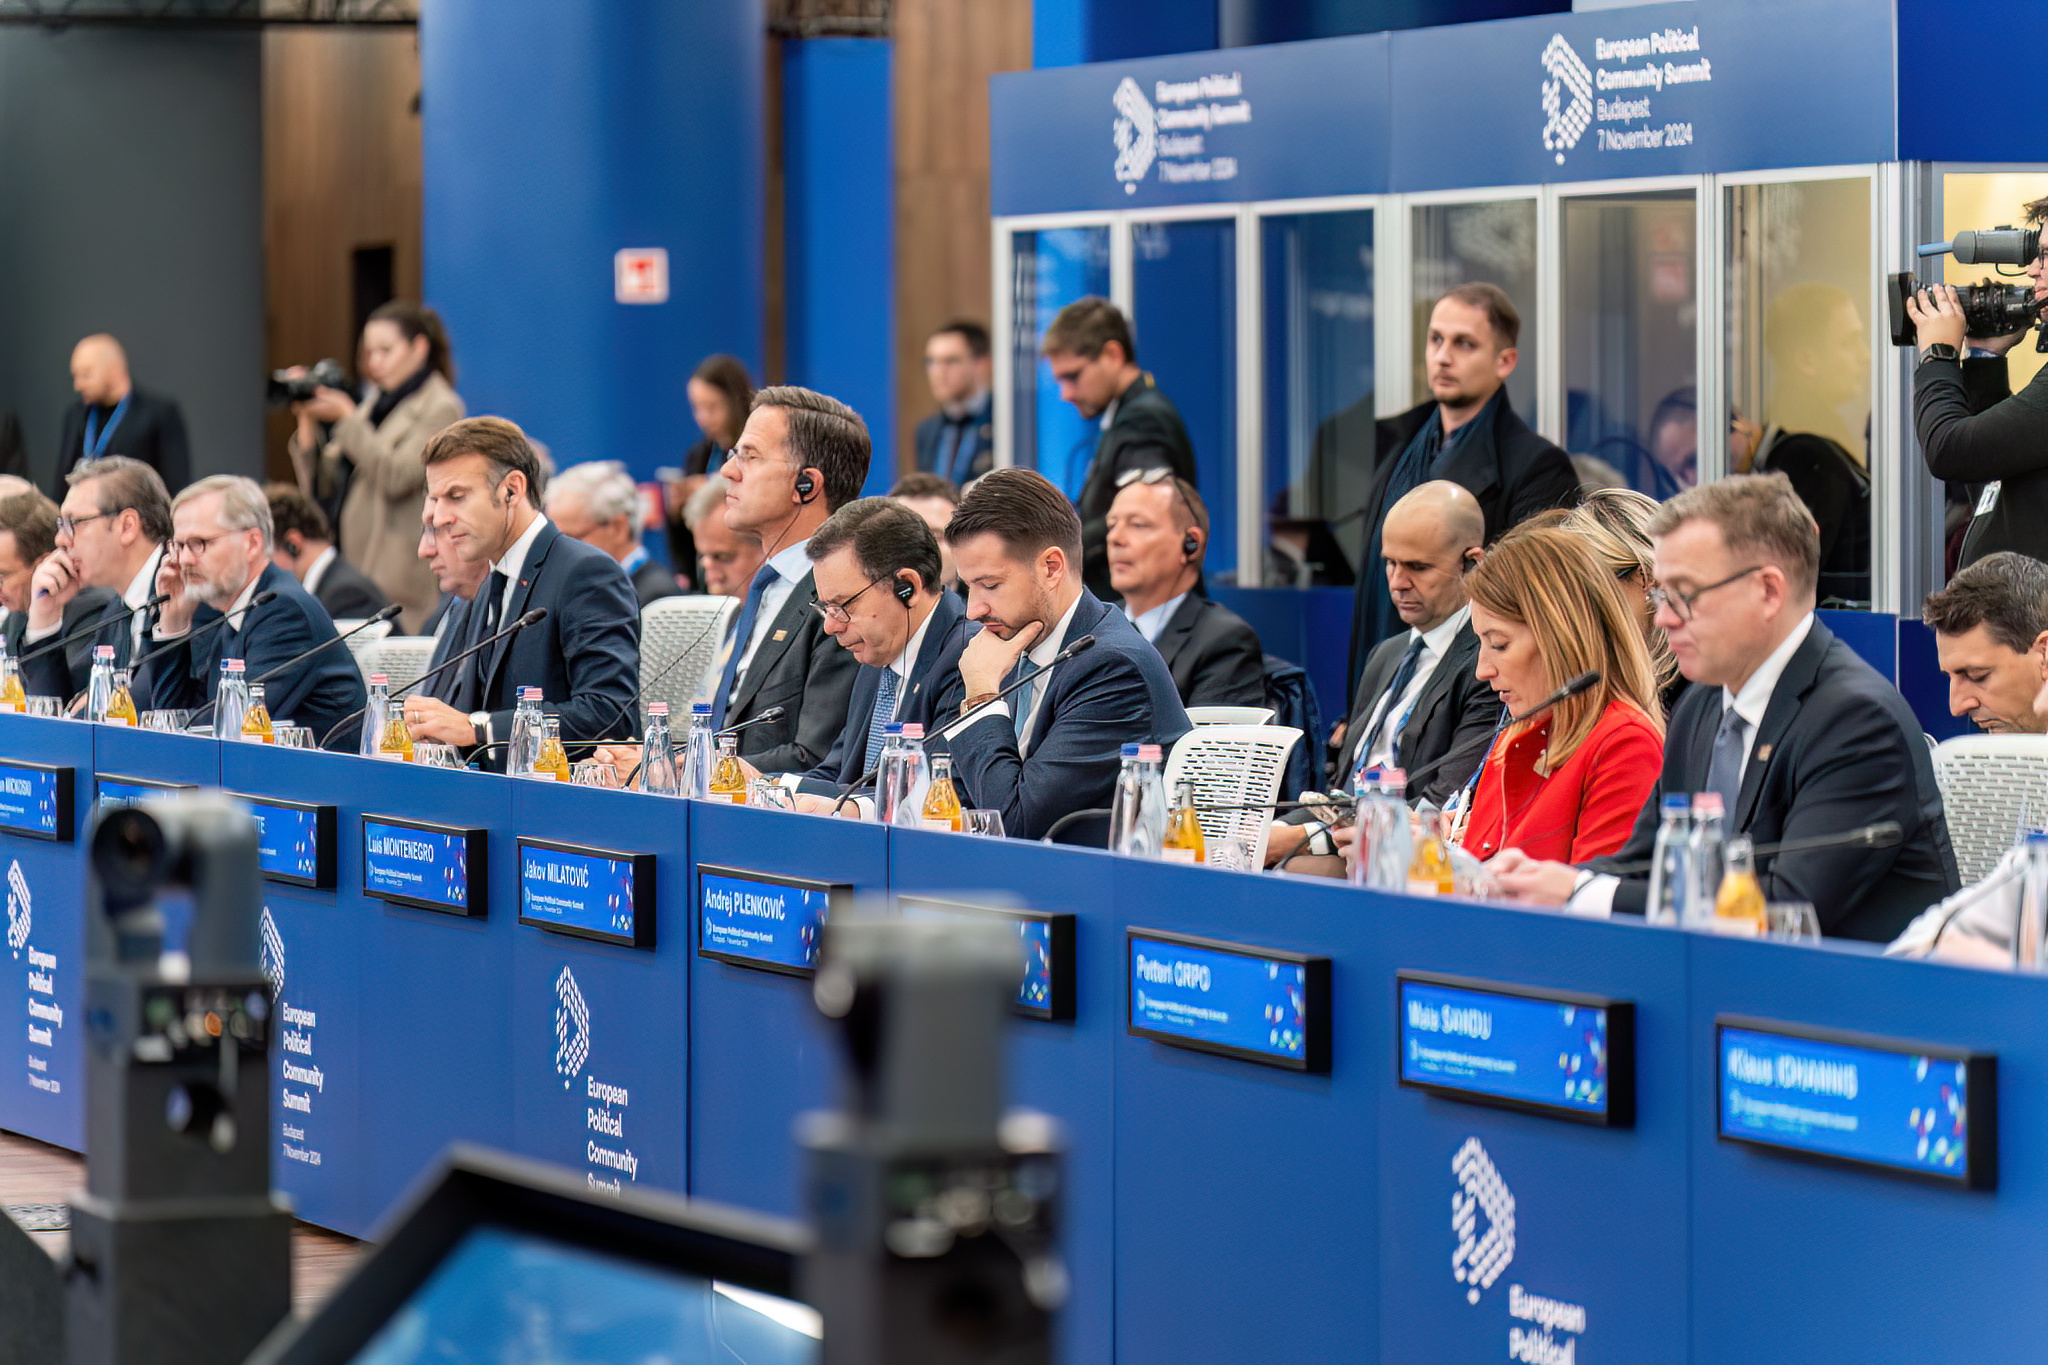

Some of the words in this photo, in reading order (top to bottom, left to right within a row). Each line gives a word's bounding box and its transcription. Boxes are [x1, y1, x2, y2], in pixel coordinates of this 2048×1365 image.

[1596, 38, 1650, 64] European
[1650, 25, 1700, 55] Political
[1596, 63, 1664, 92] Community
[1664, 57, 1711, 84] Summit
[1597, 95, 1651, 125] Budapest
[1597, 129, 1605, 151] 7
[1606, 124, 1664, 151] November
[1664, 122, 1693, 147] 2024
[383, 836, 434, 863] MONTENEGRO
[525, 858, 546, 881] Jakov
[547, 863, 589, 888] MILATOVIĆ
[705, 887, 732, 917] Andrej
[734, 892, 785, 921] PLENKOVIĆ
[282, 1002, 316, 1031] European
[282, 1030, 312, 1056] Political
[282, 1059, 324, 1093] Community
[587, 1075, 628, 1108] European
[282, 1088, 311, 1114] Summit
[587, 1107, 623, 1138] Political
[587, 1140, 638, 1181] Community
[1509, 1283, 1586, 1334] European
